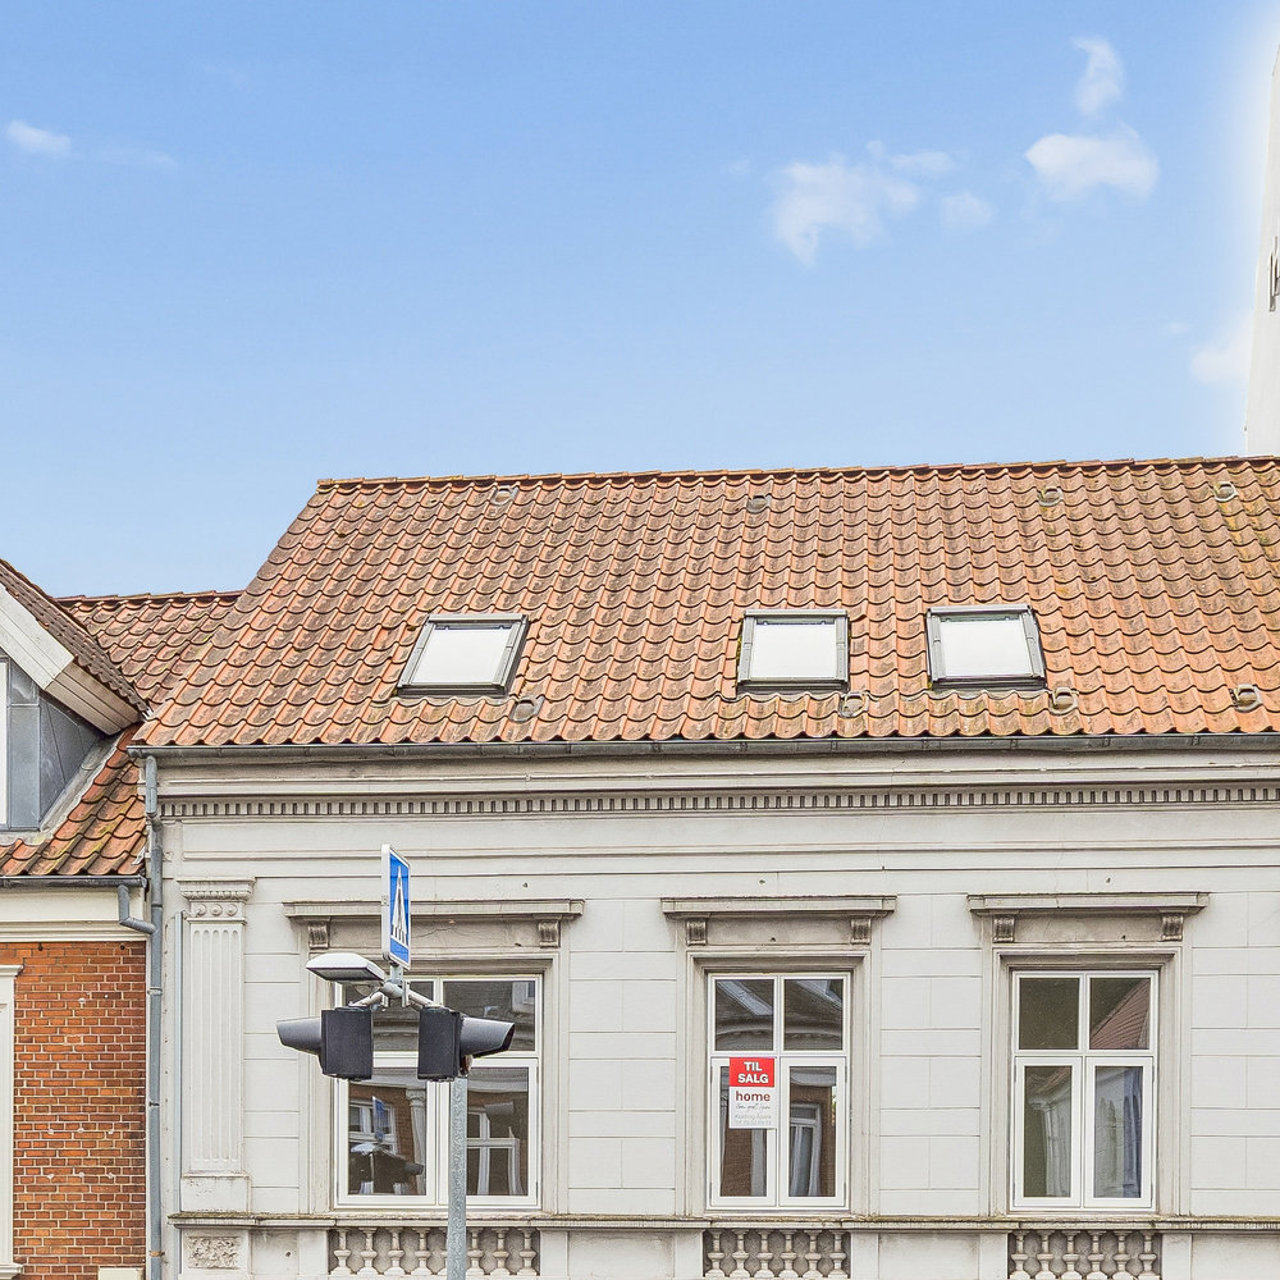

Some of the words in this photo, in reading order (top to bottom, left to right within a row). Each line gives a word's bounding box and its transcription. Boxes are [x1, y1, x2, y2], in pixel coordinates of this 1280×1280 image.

[744, 1062, 762, 1071] TIL
[738, 1073, 769, 1083] SALG
[736, 1091, 771, 1101] home
